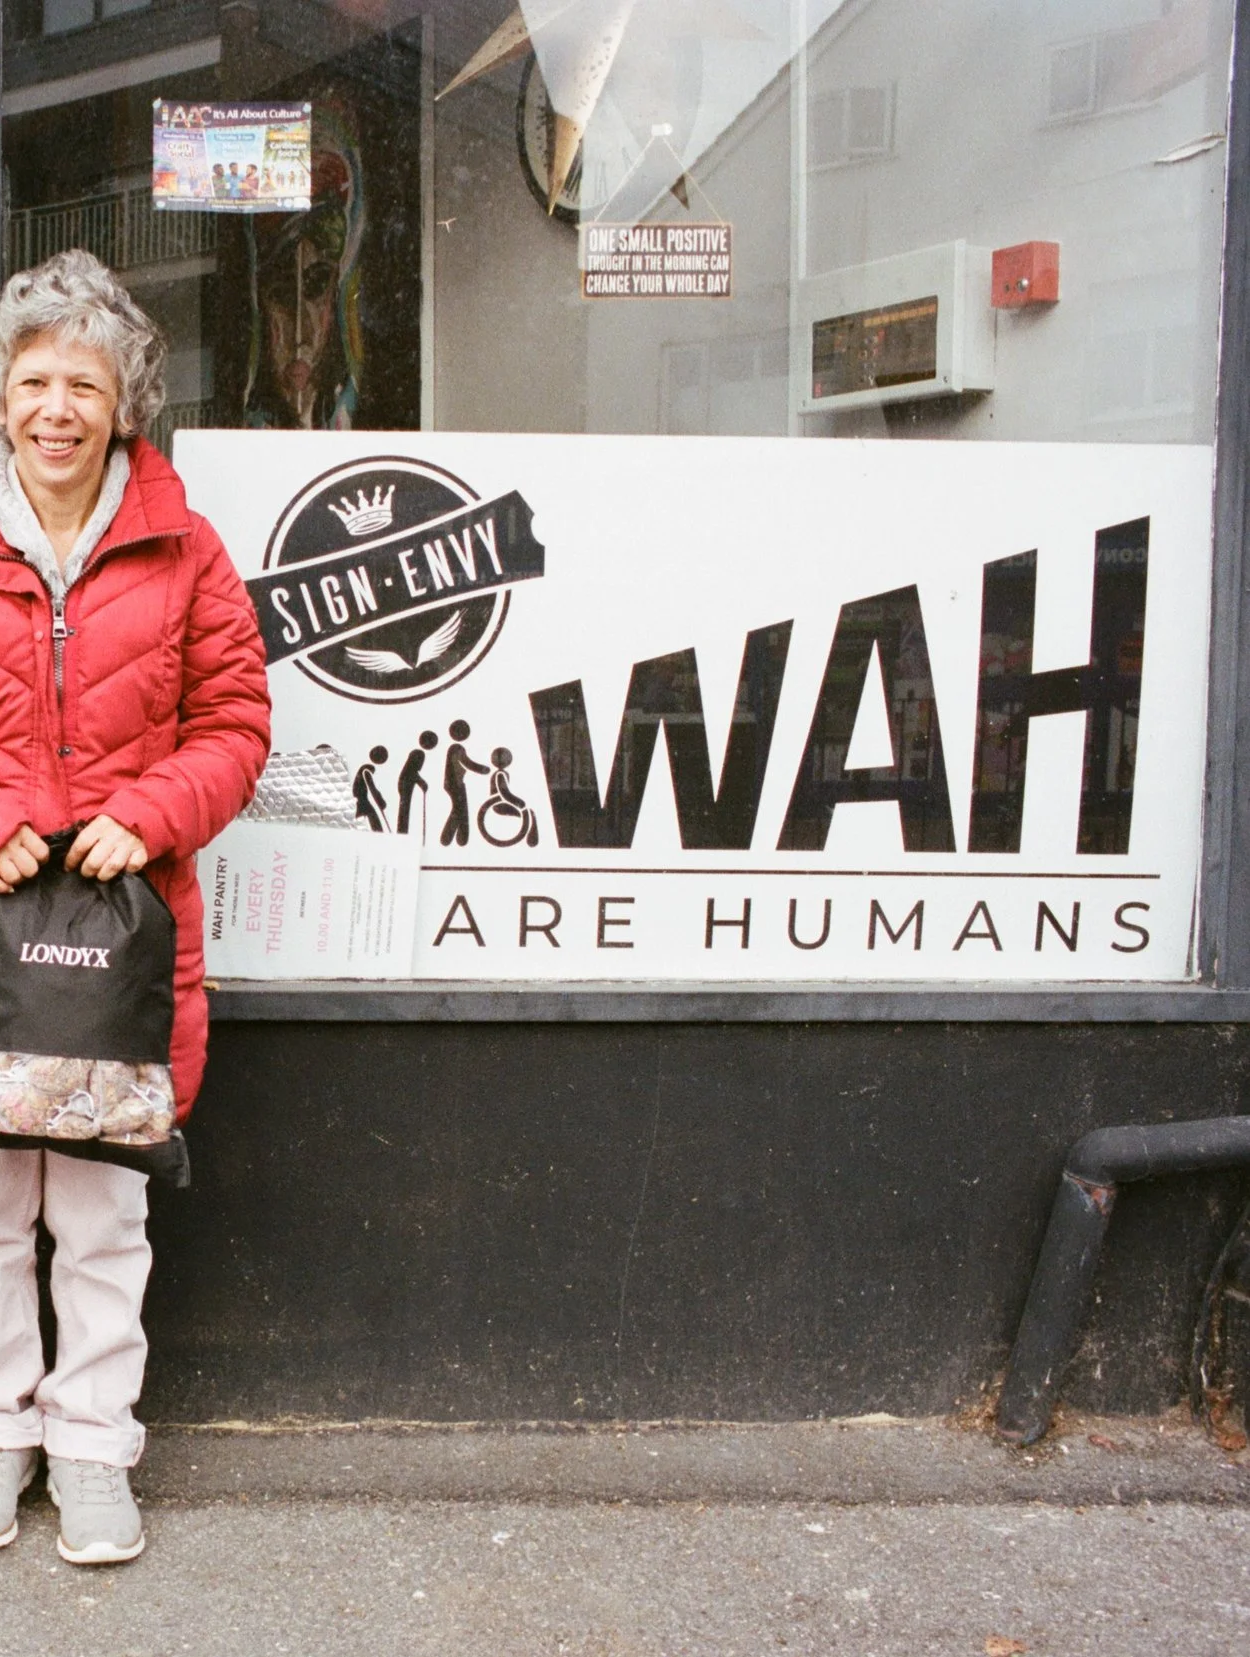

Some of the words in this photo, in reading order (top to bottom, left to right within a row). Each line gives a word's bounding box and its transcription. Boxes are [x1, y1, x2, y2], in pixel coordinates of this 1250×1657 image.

[213, 110, 226, 119] It's
[227, 110, 239, 119] All
[240, 109, 268, 119] About
[269, 108, 302, 119] Culture
[589, 228, 617, 252] ONE
[618, 228, 664, 253] SMALL
[666, 228, 728, 252] POSITIVE
[587, 254, 630, 271] THOUGHT
[632, 255, 643, 270] IN
[644, 255, 662, 270] THE
[664, 255, 709, 271] MORNING
[710, 255, 730, 271] CAN
[586, 274, 630, 294] CHANGE
[632, 274, 663, 293] YOUR
[665, 274, 705, 293] WHOLE
[707, 274, 730, 293] DAY
[269, 565, 378, 645] SIGN
[398, 518, 503, 598] ENVY
[528, 515, 1151, 855] WAH
[214, 855, 228, 908] PANTRY
[322, 857, 335, 890] 11.00
[246, 868, 265, 933] EVERY
[266, 850, 289, 955] THURSDAY
[319, 892, 332, 921] AND
[211, 910, 225, 941] WAH
[317, 922, 330, 953] 10.00
[432, 894, 636, 949] ARE
[705, 897, 1152, 953] HUMANS
[19, 942, 111, 969] LONDYX
